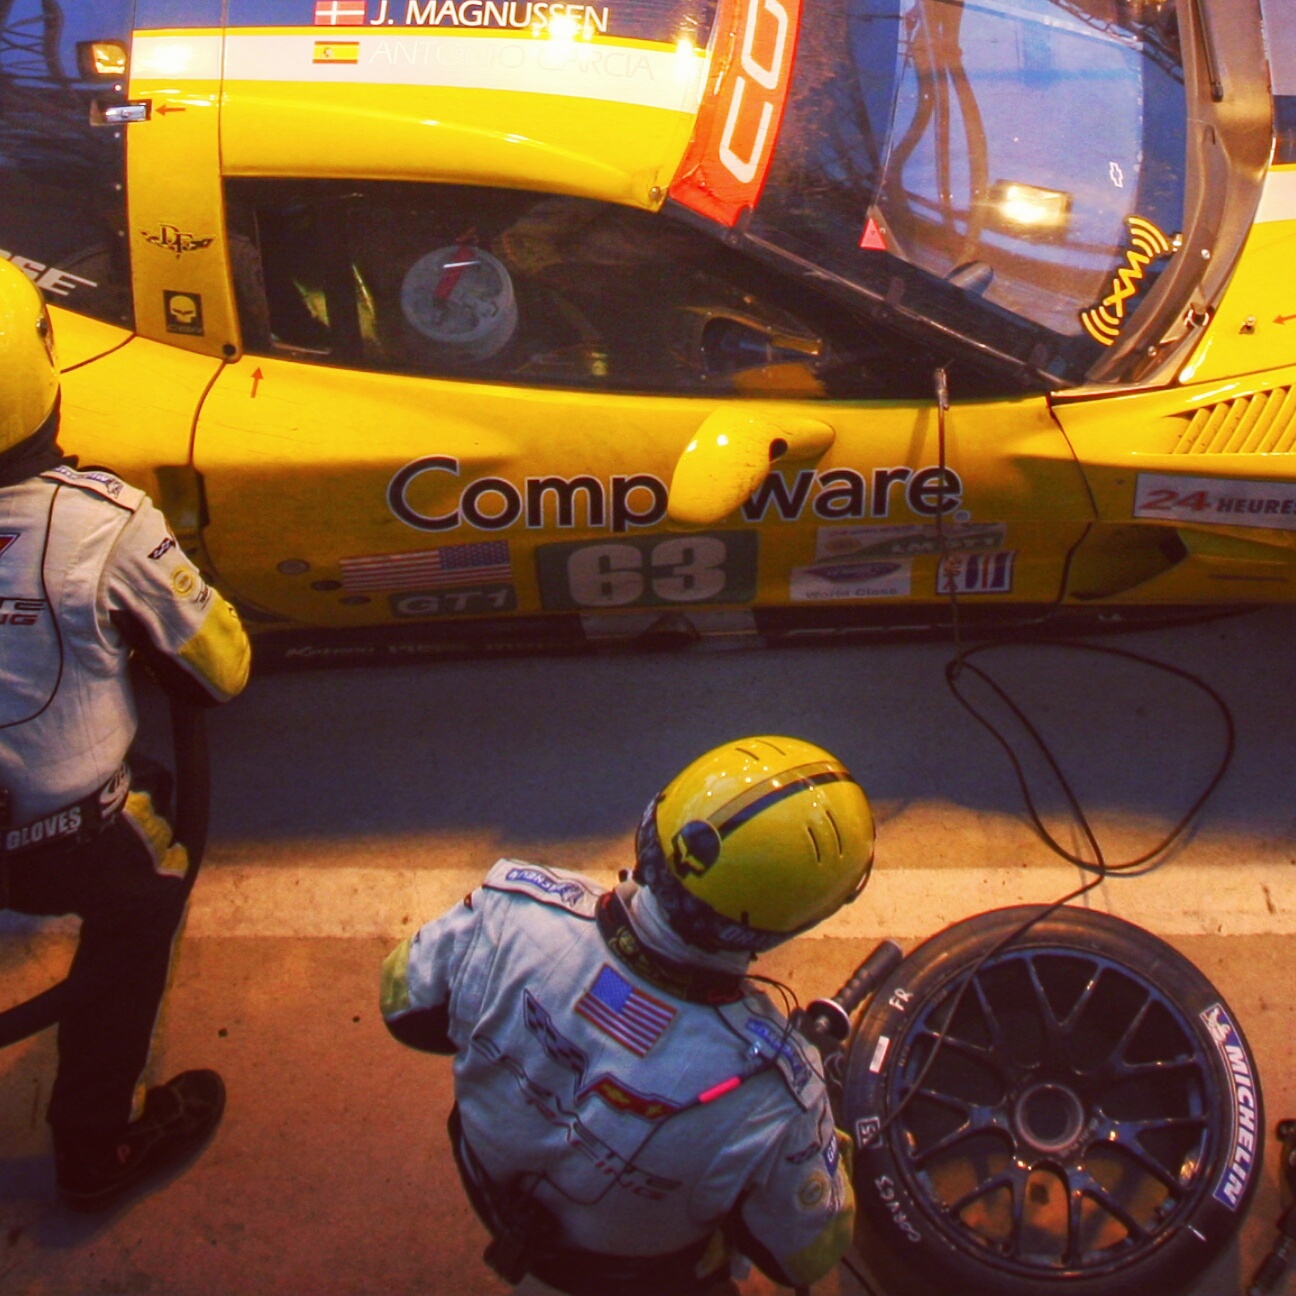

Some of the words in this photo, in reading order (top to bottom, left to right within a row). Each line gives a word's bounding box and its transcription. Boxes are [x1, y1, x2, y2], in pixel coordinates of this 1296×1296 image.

[369, 0, 396, 25] J.
[404, 0, 610, 33] MAGNUSSEN
[386, 455, 964, 532] Compware
[1140, 487, 1212, 513] 24
[566, 535, 728, 608] 63
[397, 585, 508, 616] GT1
[806, 588, 854, 600] World
[857, 587, 897, 599] Class
[5, 805, 82, 851] GLOVES
[889, 987, 914, 1013] FR
[1221, 1041, 1258, 1209] MICHELIN
